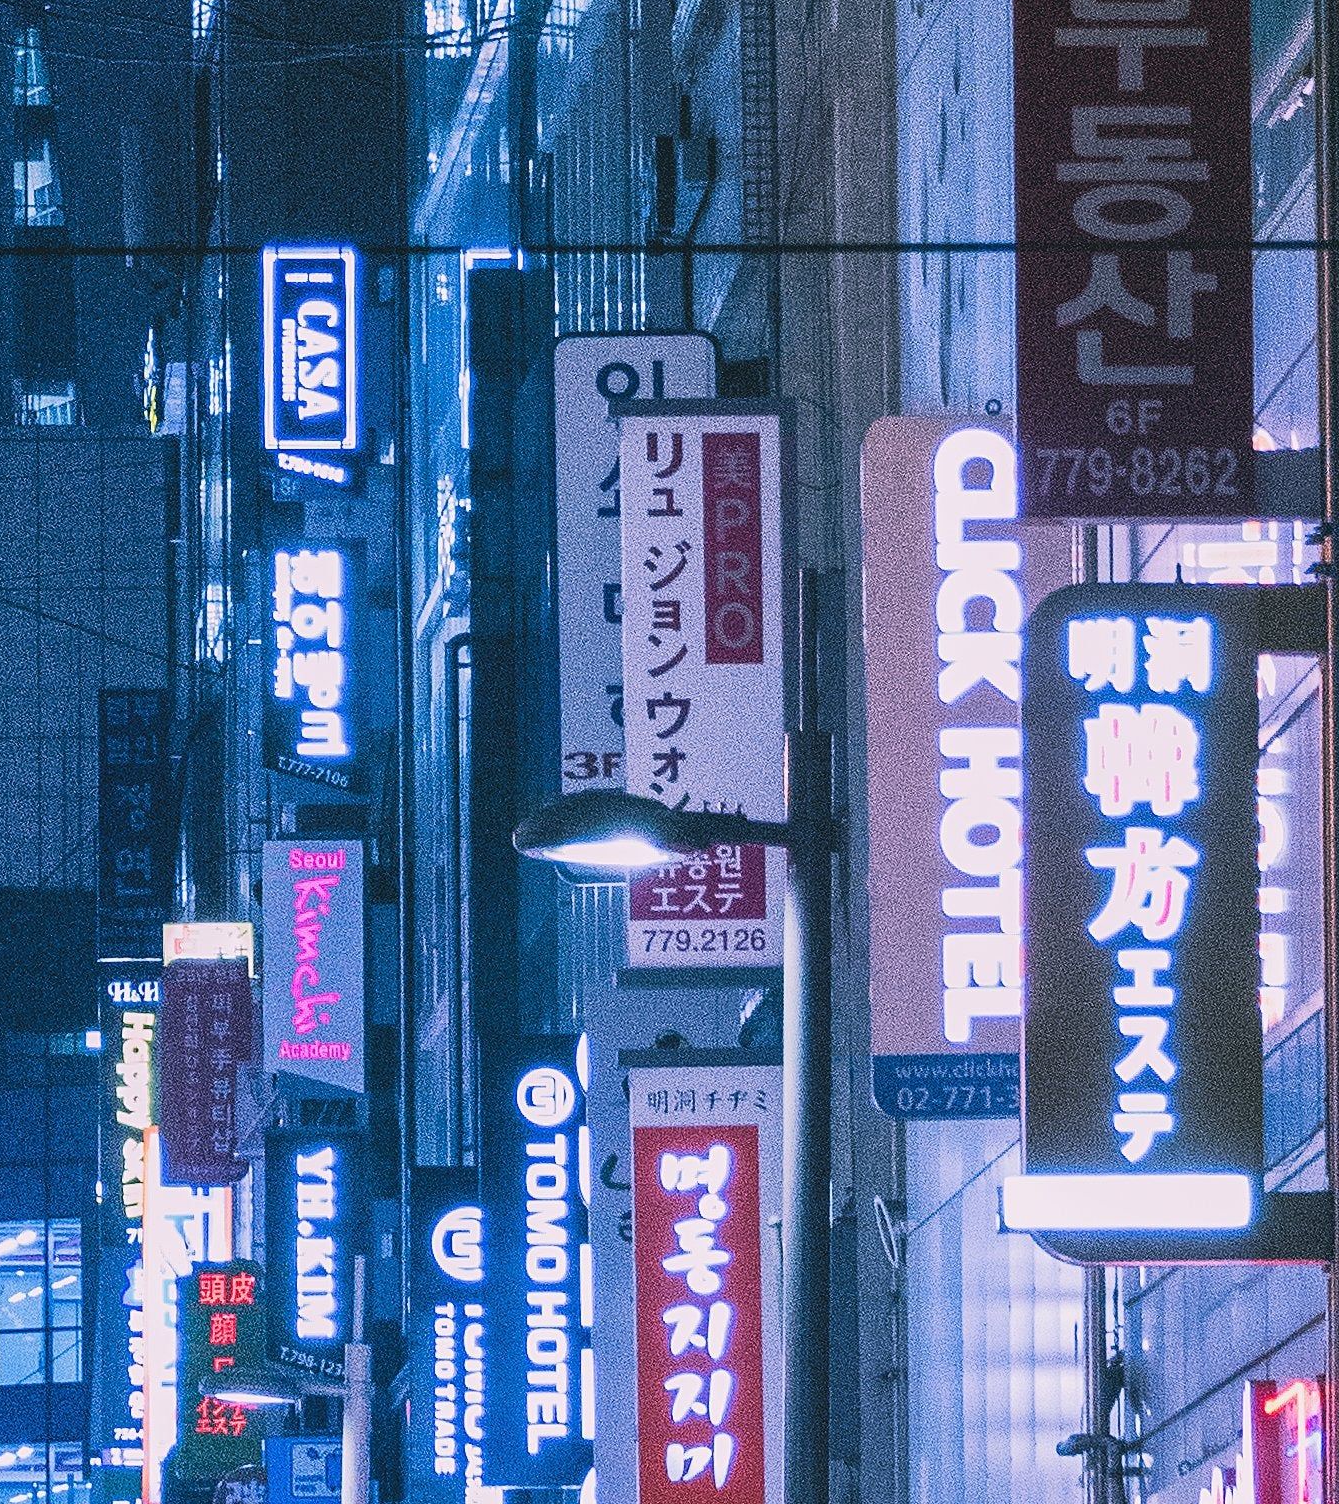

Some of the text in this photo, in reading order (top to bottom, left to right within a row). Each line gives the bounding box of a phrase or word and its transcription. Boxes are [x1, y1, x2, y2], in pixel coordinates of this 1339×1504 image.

[297, 300, 339, 421] CASA
[1105, 399, 1163, 434] 6F
[1035, 447, 1241, 496] 779-8262
[932, 427, 1023, 1045] CLICK HOTEL
[562, 750, 623, 782] 3F
[289, 849, 347, 870] Seoul
[649, 883, 744, 914] エステ
[289, 875, 341, 1035] Kimchi
[642, 928, 767, 953] 779.2126
[279, 1040, 353, 1061] Academy
[295, 1146, 334, 1340] YH.KIM
[198, 1272, 256, 1305] 頭皮
[523, 1133, 568, 1456] TOMO HOTEL
[660, 1143, 733, 1489] 명동지지미
